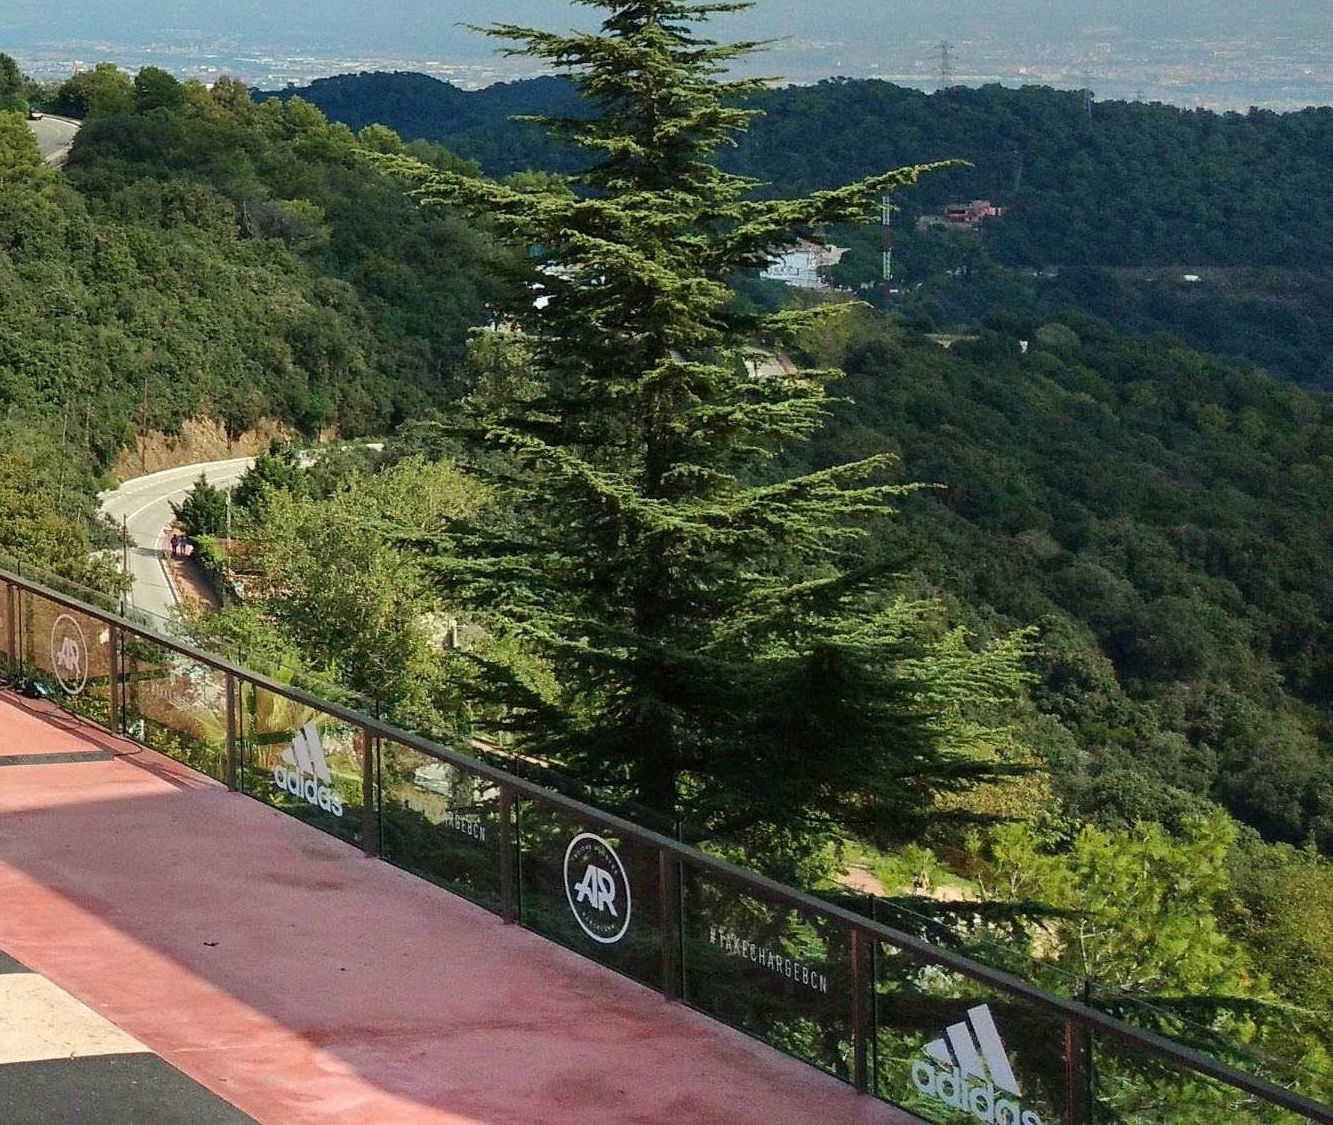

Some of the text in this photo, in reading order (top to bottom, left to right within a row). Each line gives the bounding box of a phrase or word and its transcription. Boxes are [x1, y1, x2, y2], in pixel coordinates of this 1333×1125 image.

[274, 764, 343, 817] adidas
[574, 864, 619, 917] AR
[708, 925, 828, 994] #TAKECHARGEBCN
